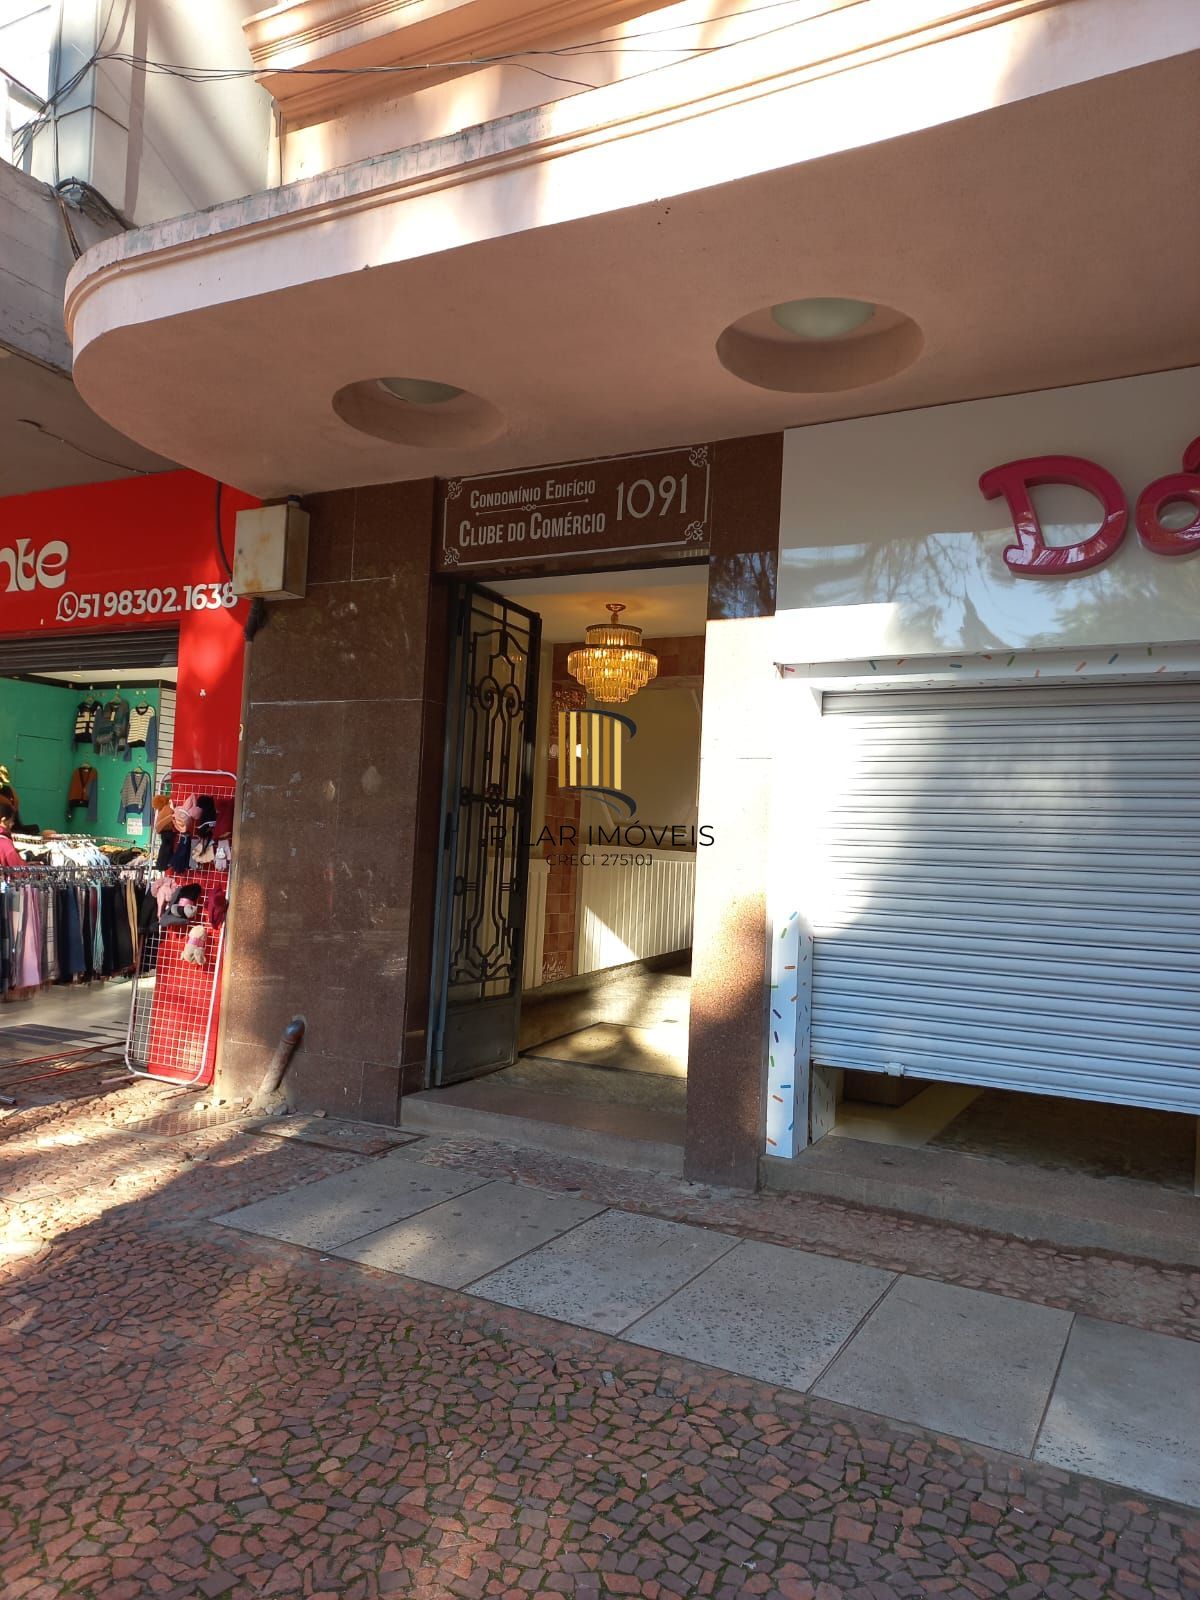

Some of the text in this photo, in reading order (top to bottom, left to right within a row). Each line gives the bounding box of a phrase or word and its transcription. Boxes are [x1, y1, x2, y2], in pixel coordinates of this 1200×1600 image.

[470, 480, 596, 509] CONDOMÍNIO EDIFÍCIO
[616, 473, 688, 521] 1091
[459, 511, 606, 547] CLUBE DO COMÉRCIO
